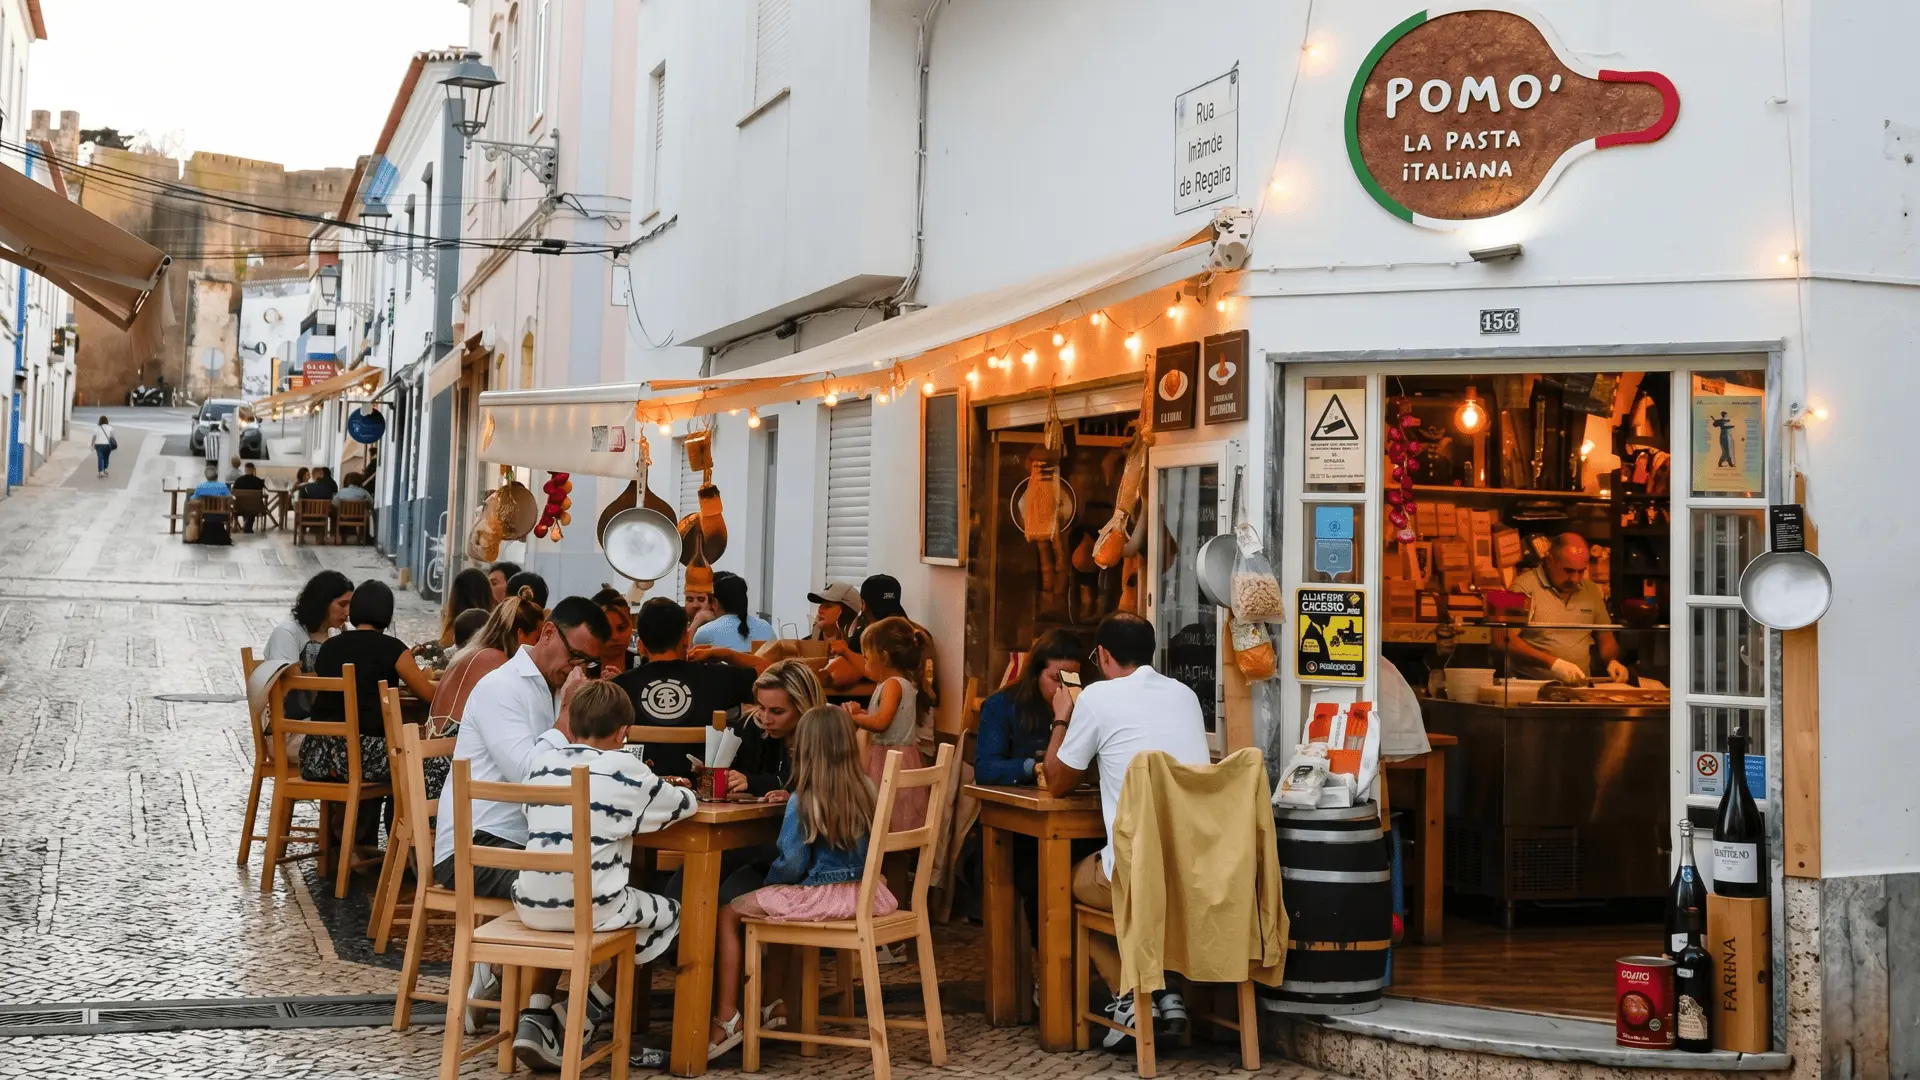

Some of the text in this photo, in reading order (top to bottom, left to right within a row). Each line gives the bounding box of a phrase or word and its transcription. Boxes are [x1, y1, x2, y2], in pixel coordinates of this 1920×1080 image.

[1196, 102, 1215, 125] Rua
[1404, 130, 1521, 152] LA PASTA
[1179, 175, 1192, 197] de
